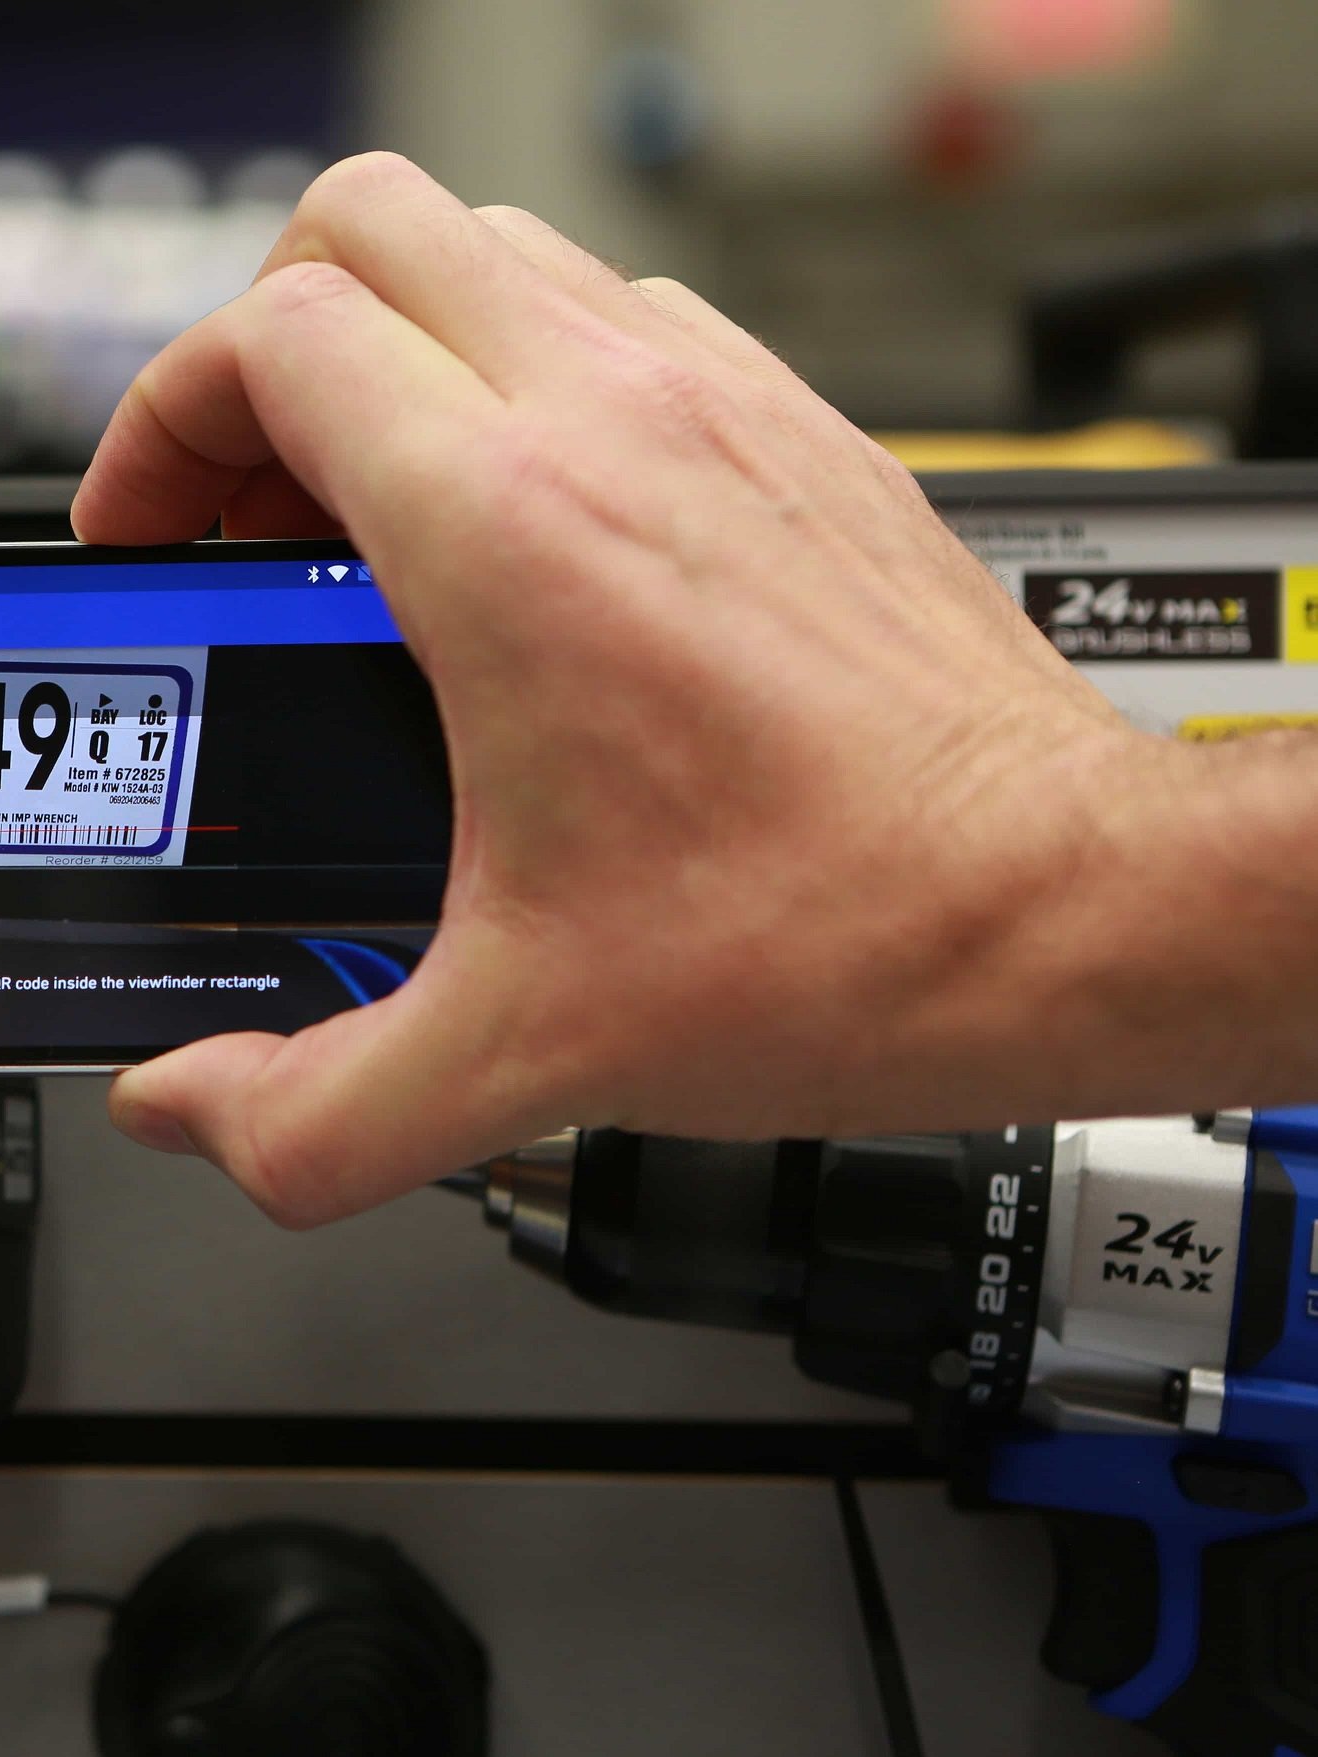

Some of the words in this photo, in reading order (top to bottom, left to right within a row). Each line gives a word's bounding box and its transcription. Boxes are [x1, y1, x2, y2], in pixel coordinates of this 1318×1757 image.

[90, 709, 119, 724] BAY
[139, 709, 167, 726] LOC
[89, 730, 110, 764] Q
[138, 732, 168, 761] 17
[68, 767, 98, 780] Item
[103, 768, 111, 780] #
[115, 768, 166, 781] 672825
[64, 782, 90, 793] Model
[93, 783, 99, 792] #
[122, 783, 164, 793] 1524A-03
[11, 813, 31, 823] IMP
[34, 814, 78, 823] WRENCH
[45, 855, 97, 865] Reorder
[100, 856, 109, 865] #
[113, 855, 164, 865] G212159
[15, 977, 49, 990] code
[53, 976, 97, 990] inside
[101, 976, 125, 989] the
[128, 975, 206, 989] viewfinder
[210, 974, 280, 991] rectangle
[987, 1173, 1021, 1240] 22
[977, 1253, 1011, 1315] 20
[1102, 1261, 1213, 1293] MAX
